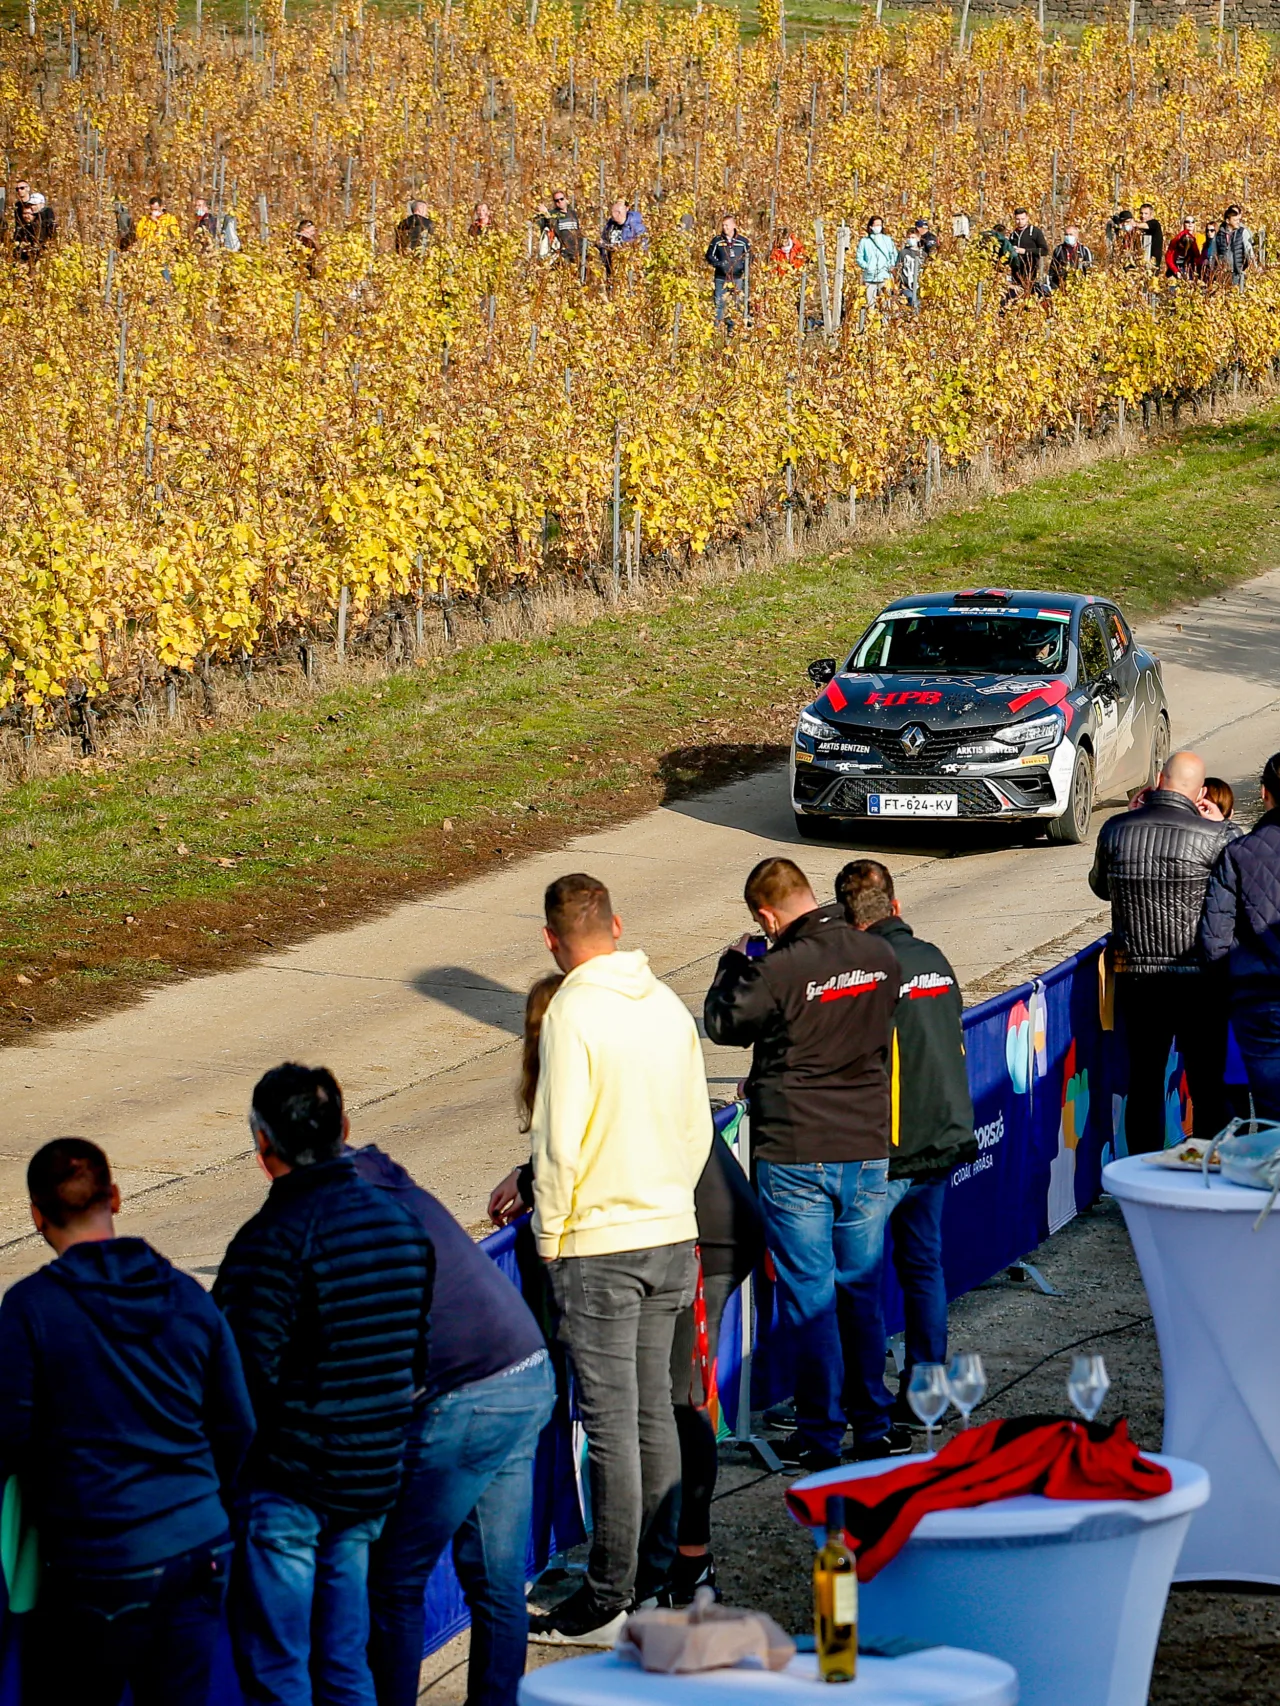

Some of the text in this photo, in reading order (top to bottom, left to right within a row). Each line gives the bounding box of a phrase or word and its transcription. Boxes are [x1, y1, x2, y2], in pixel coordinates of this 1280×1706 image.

[864, 691, 944, 706] HPB
[818, 743, 840, 751] ARKTIS
[840, 743, 870, 754] BENTZEN
[956, 745, 1019, 755] ARKTIS BENTZEN
[884, 799, 953, 811] FT-624-KY
